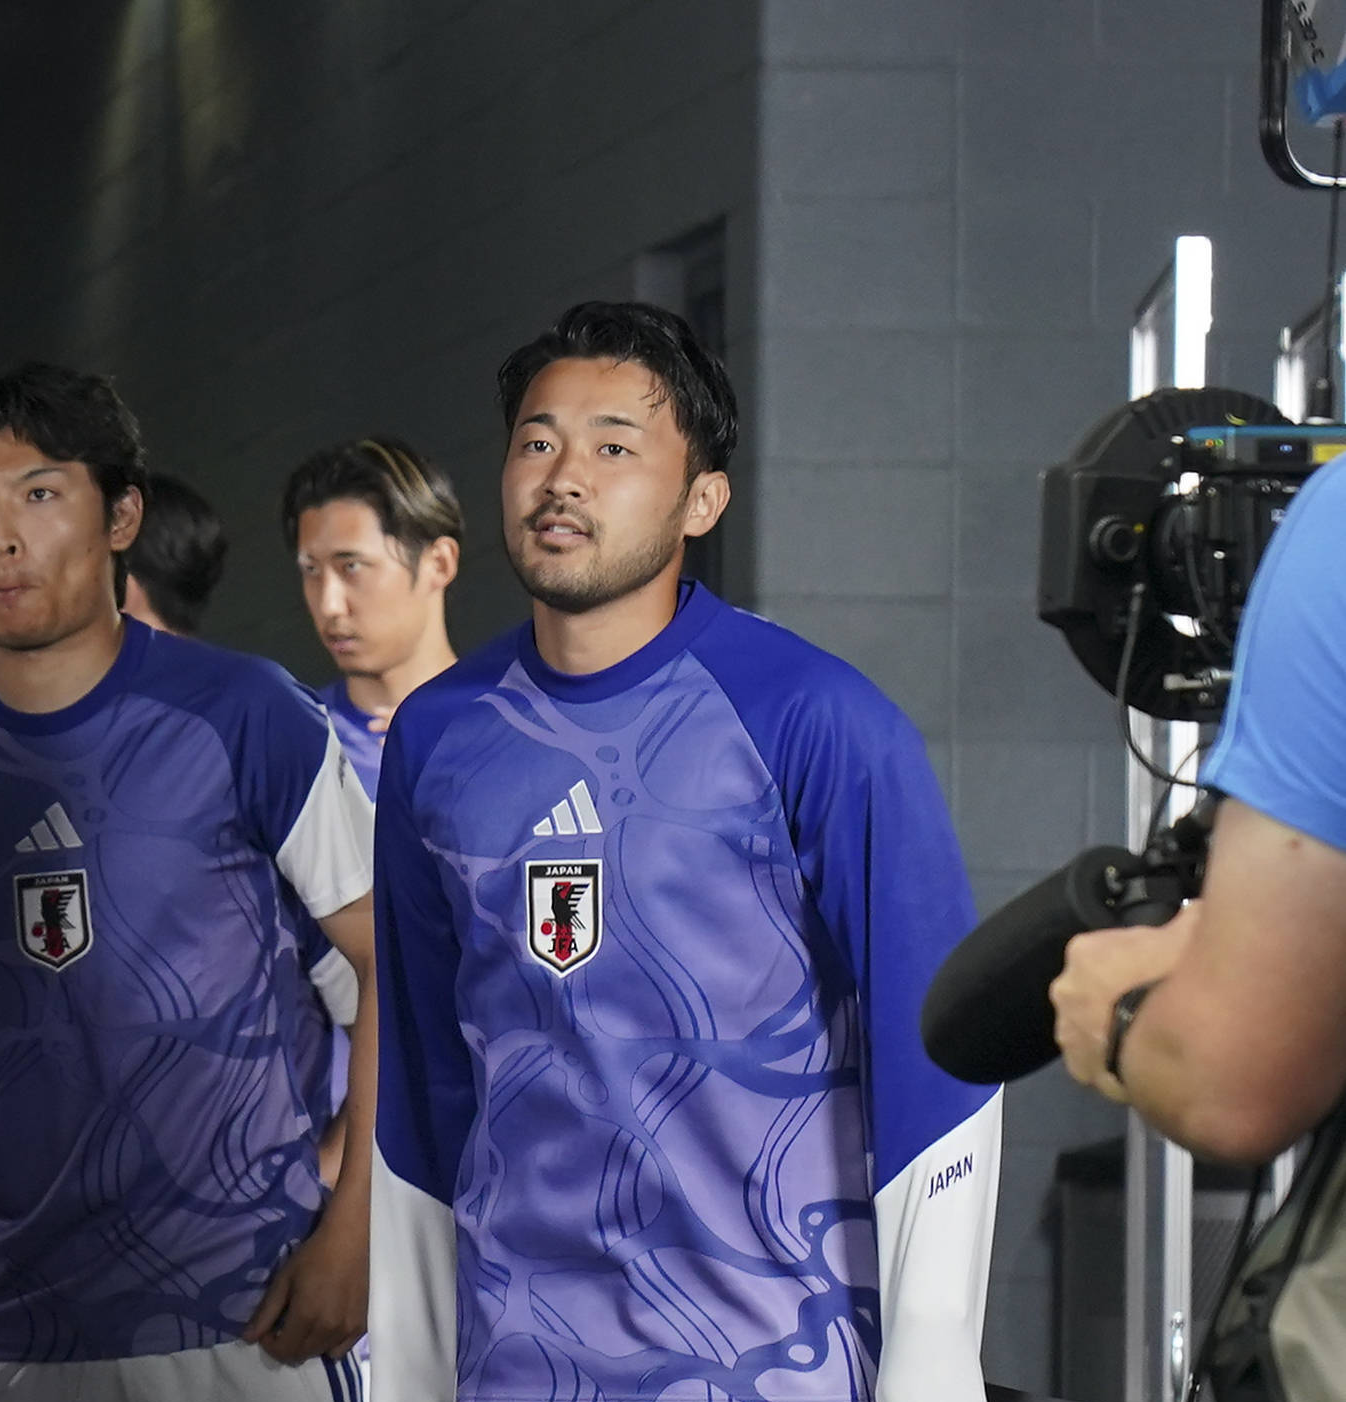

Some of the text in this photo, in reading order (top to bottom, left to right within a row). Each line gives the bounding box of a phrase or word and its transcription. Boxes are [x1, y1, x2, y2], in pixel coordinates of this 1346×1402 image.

[545, 865, 583, 876] JAPAN
[547, 937, 579, 954] JFA
[928, 1152, 973, 1199] JAPAN
